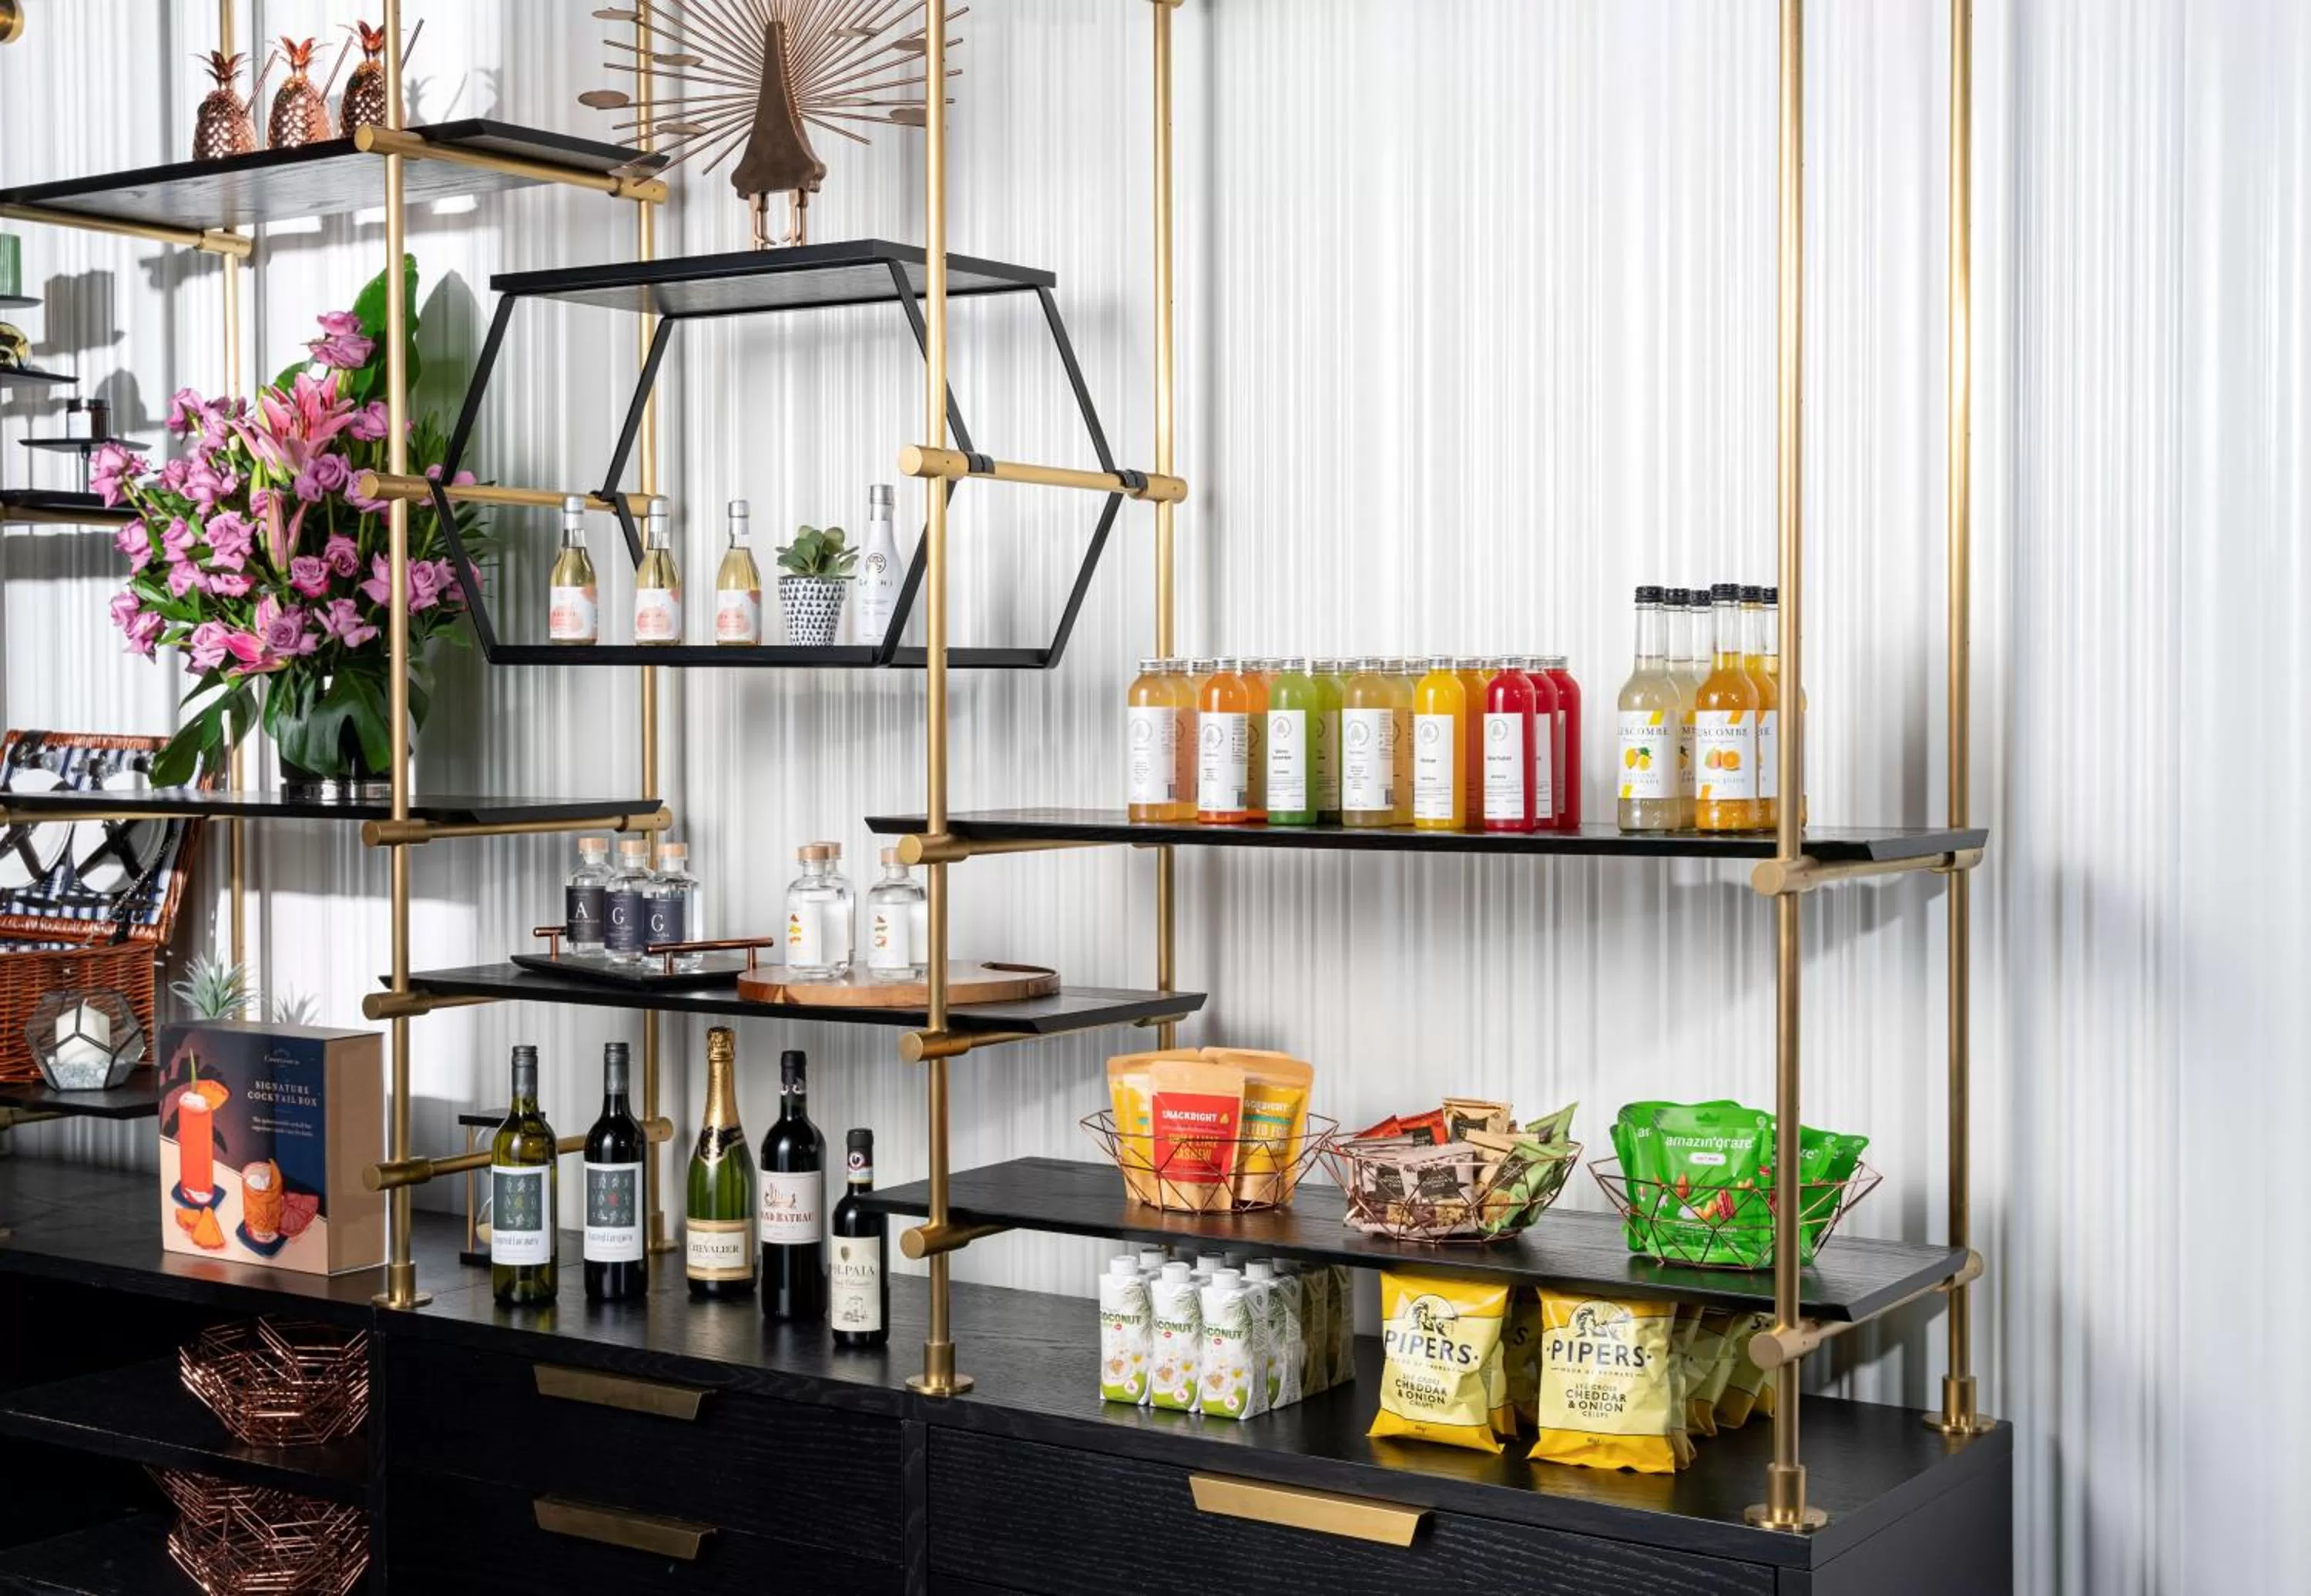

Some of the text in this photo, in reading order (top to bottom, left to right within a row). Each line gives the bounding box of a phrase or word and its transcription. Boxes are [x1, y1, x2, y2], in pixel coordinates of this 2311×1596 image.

[575, 901, 589, 919] A
[612, 907, 626, 925] G
[651, 914, 665, 933] G
[255, 1080, 310, 1095] SIGNATURE
[247, 1090, 317, 1107] COCKTAIL BOX
[1384, 1329, 1472, 1364] PIPERS
[1551, 1340, 1645, 1367] PIPERS
[1395, 1379, 1447, 1396] CHEDDAR
[1565, 1389, 1626, 1403] CHEDDAR
[1406, 1390, 1445, 1404] ONION
[1568, 1400, 1623, 1413] & ONION
